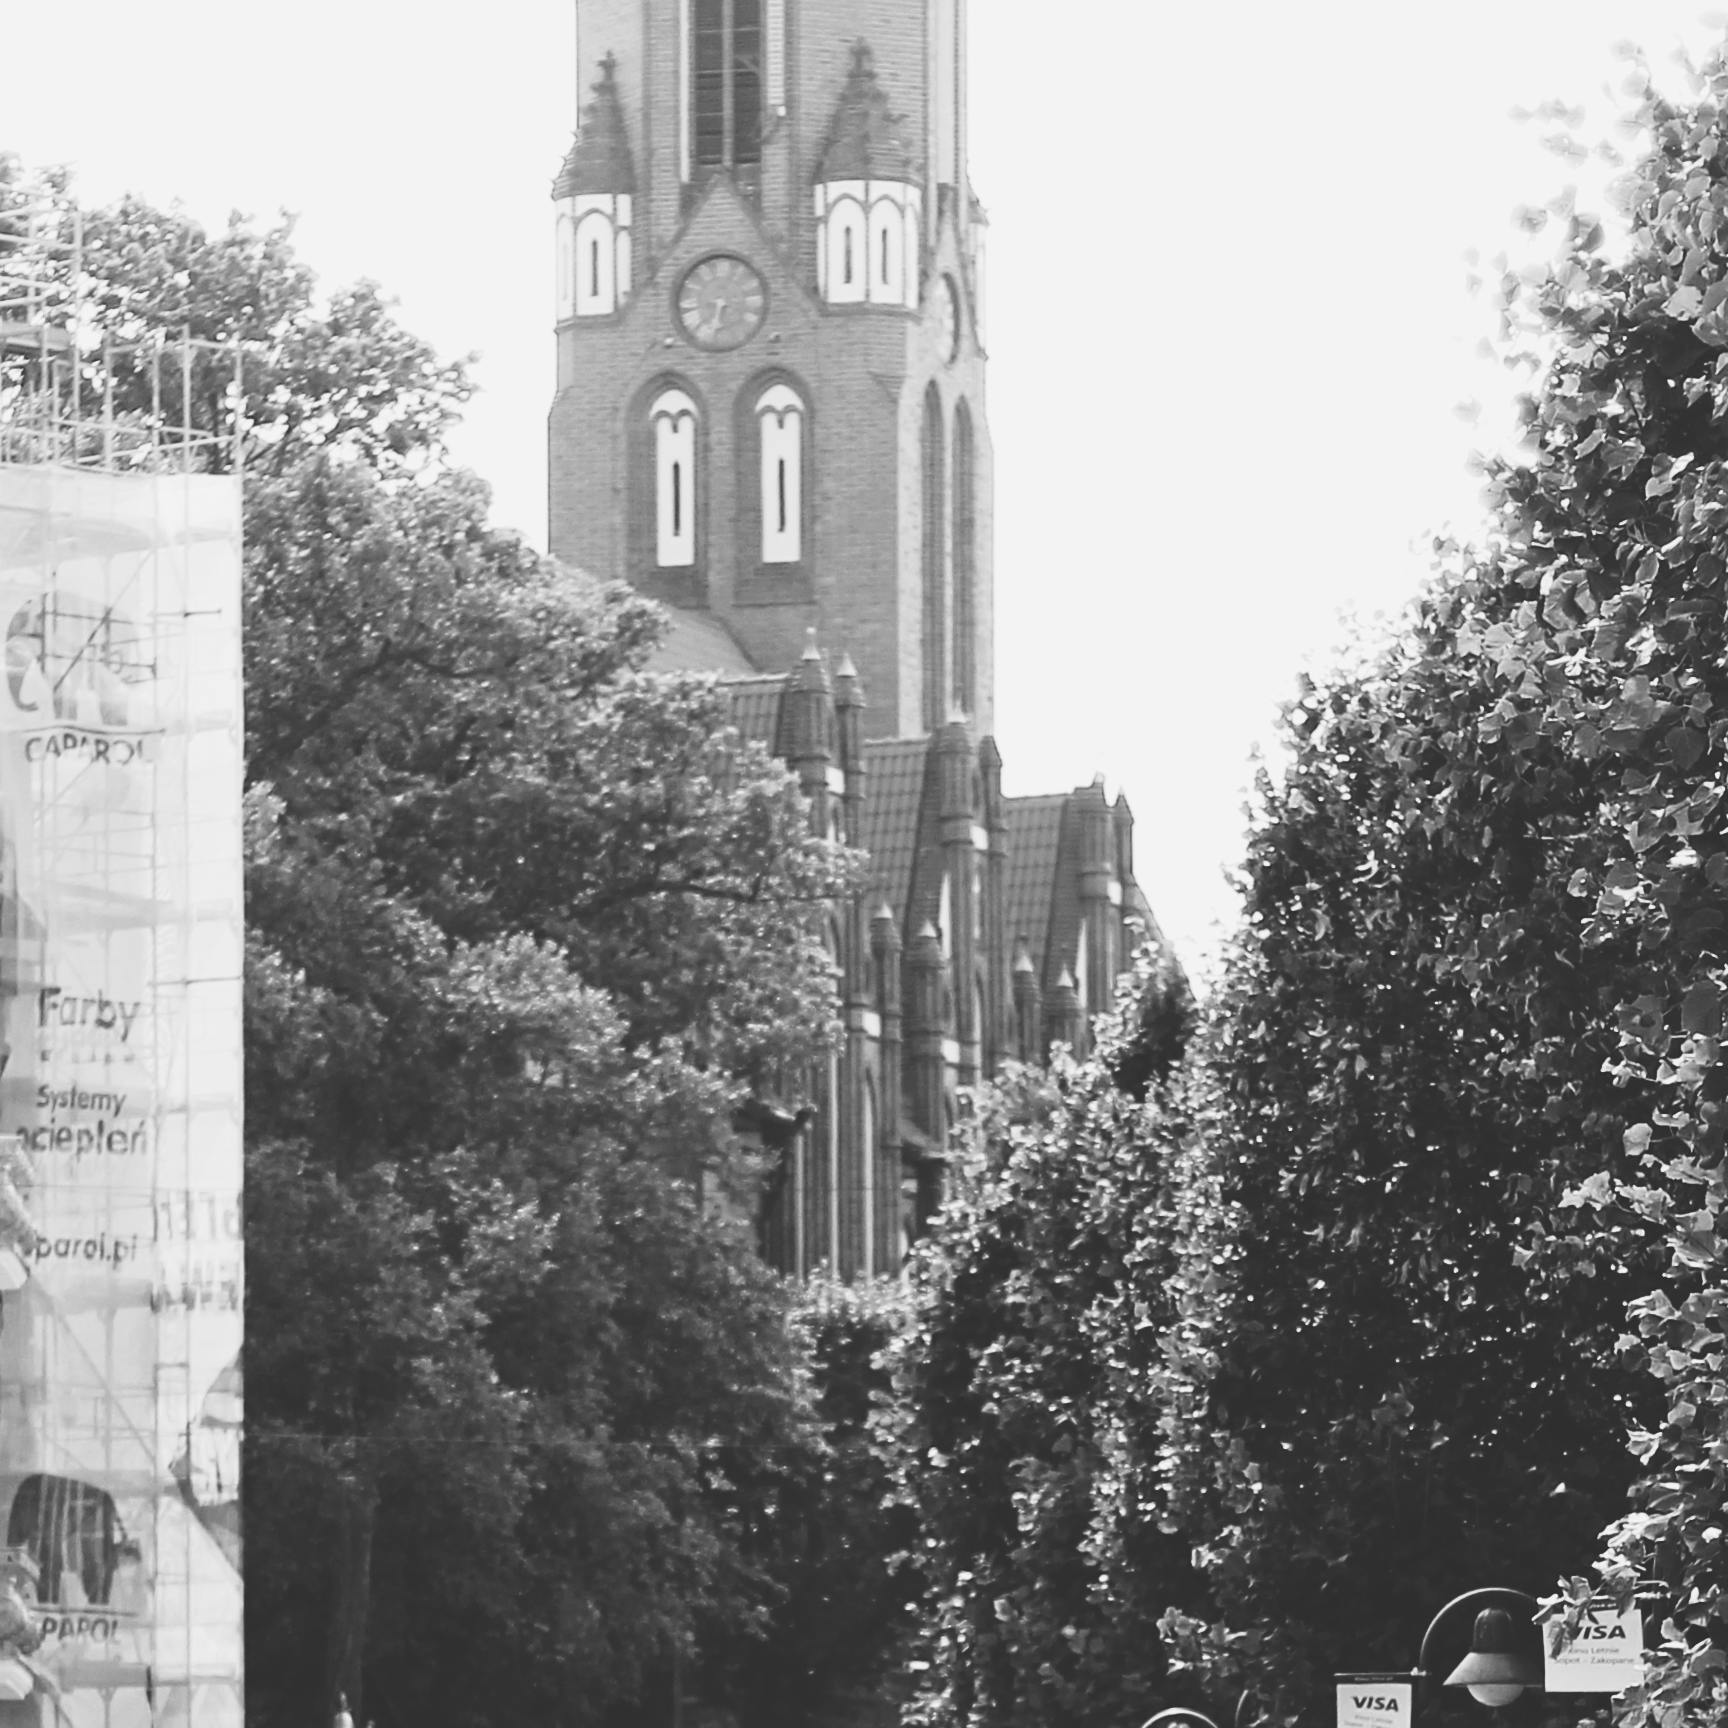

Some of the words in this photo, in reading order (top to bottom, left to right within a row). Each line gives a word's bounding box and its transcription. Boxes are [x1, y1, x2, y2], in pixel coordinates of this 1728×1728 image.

[38, 987, 140, 1042] Farby
[36, 1084, 126, 1117] Systemy
[1351, 1695, 1399, 1712] VISA
